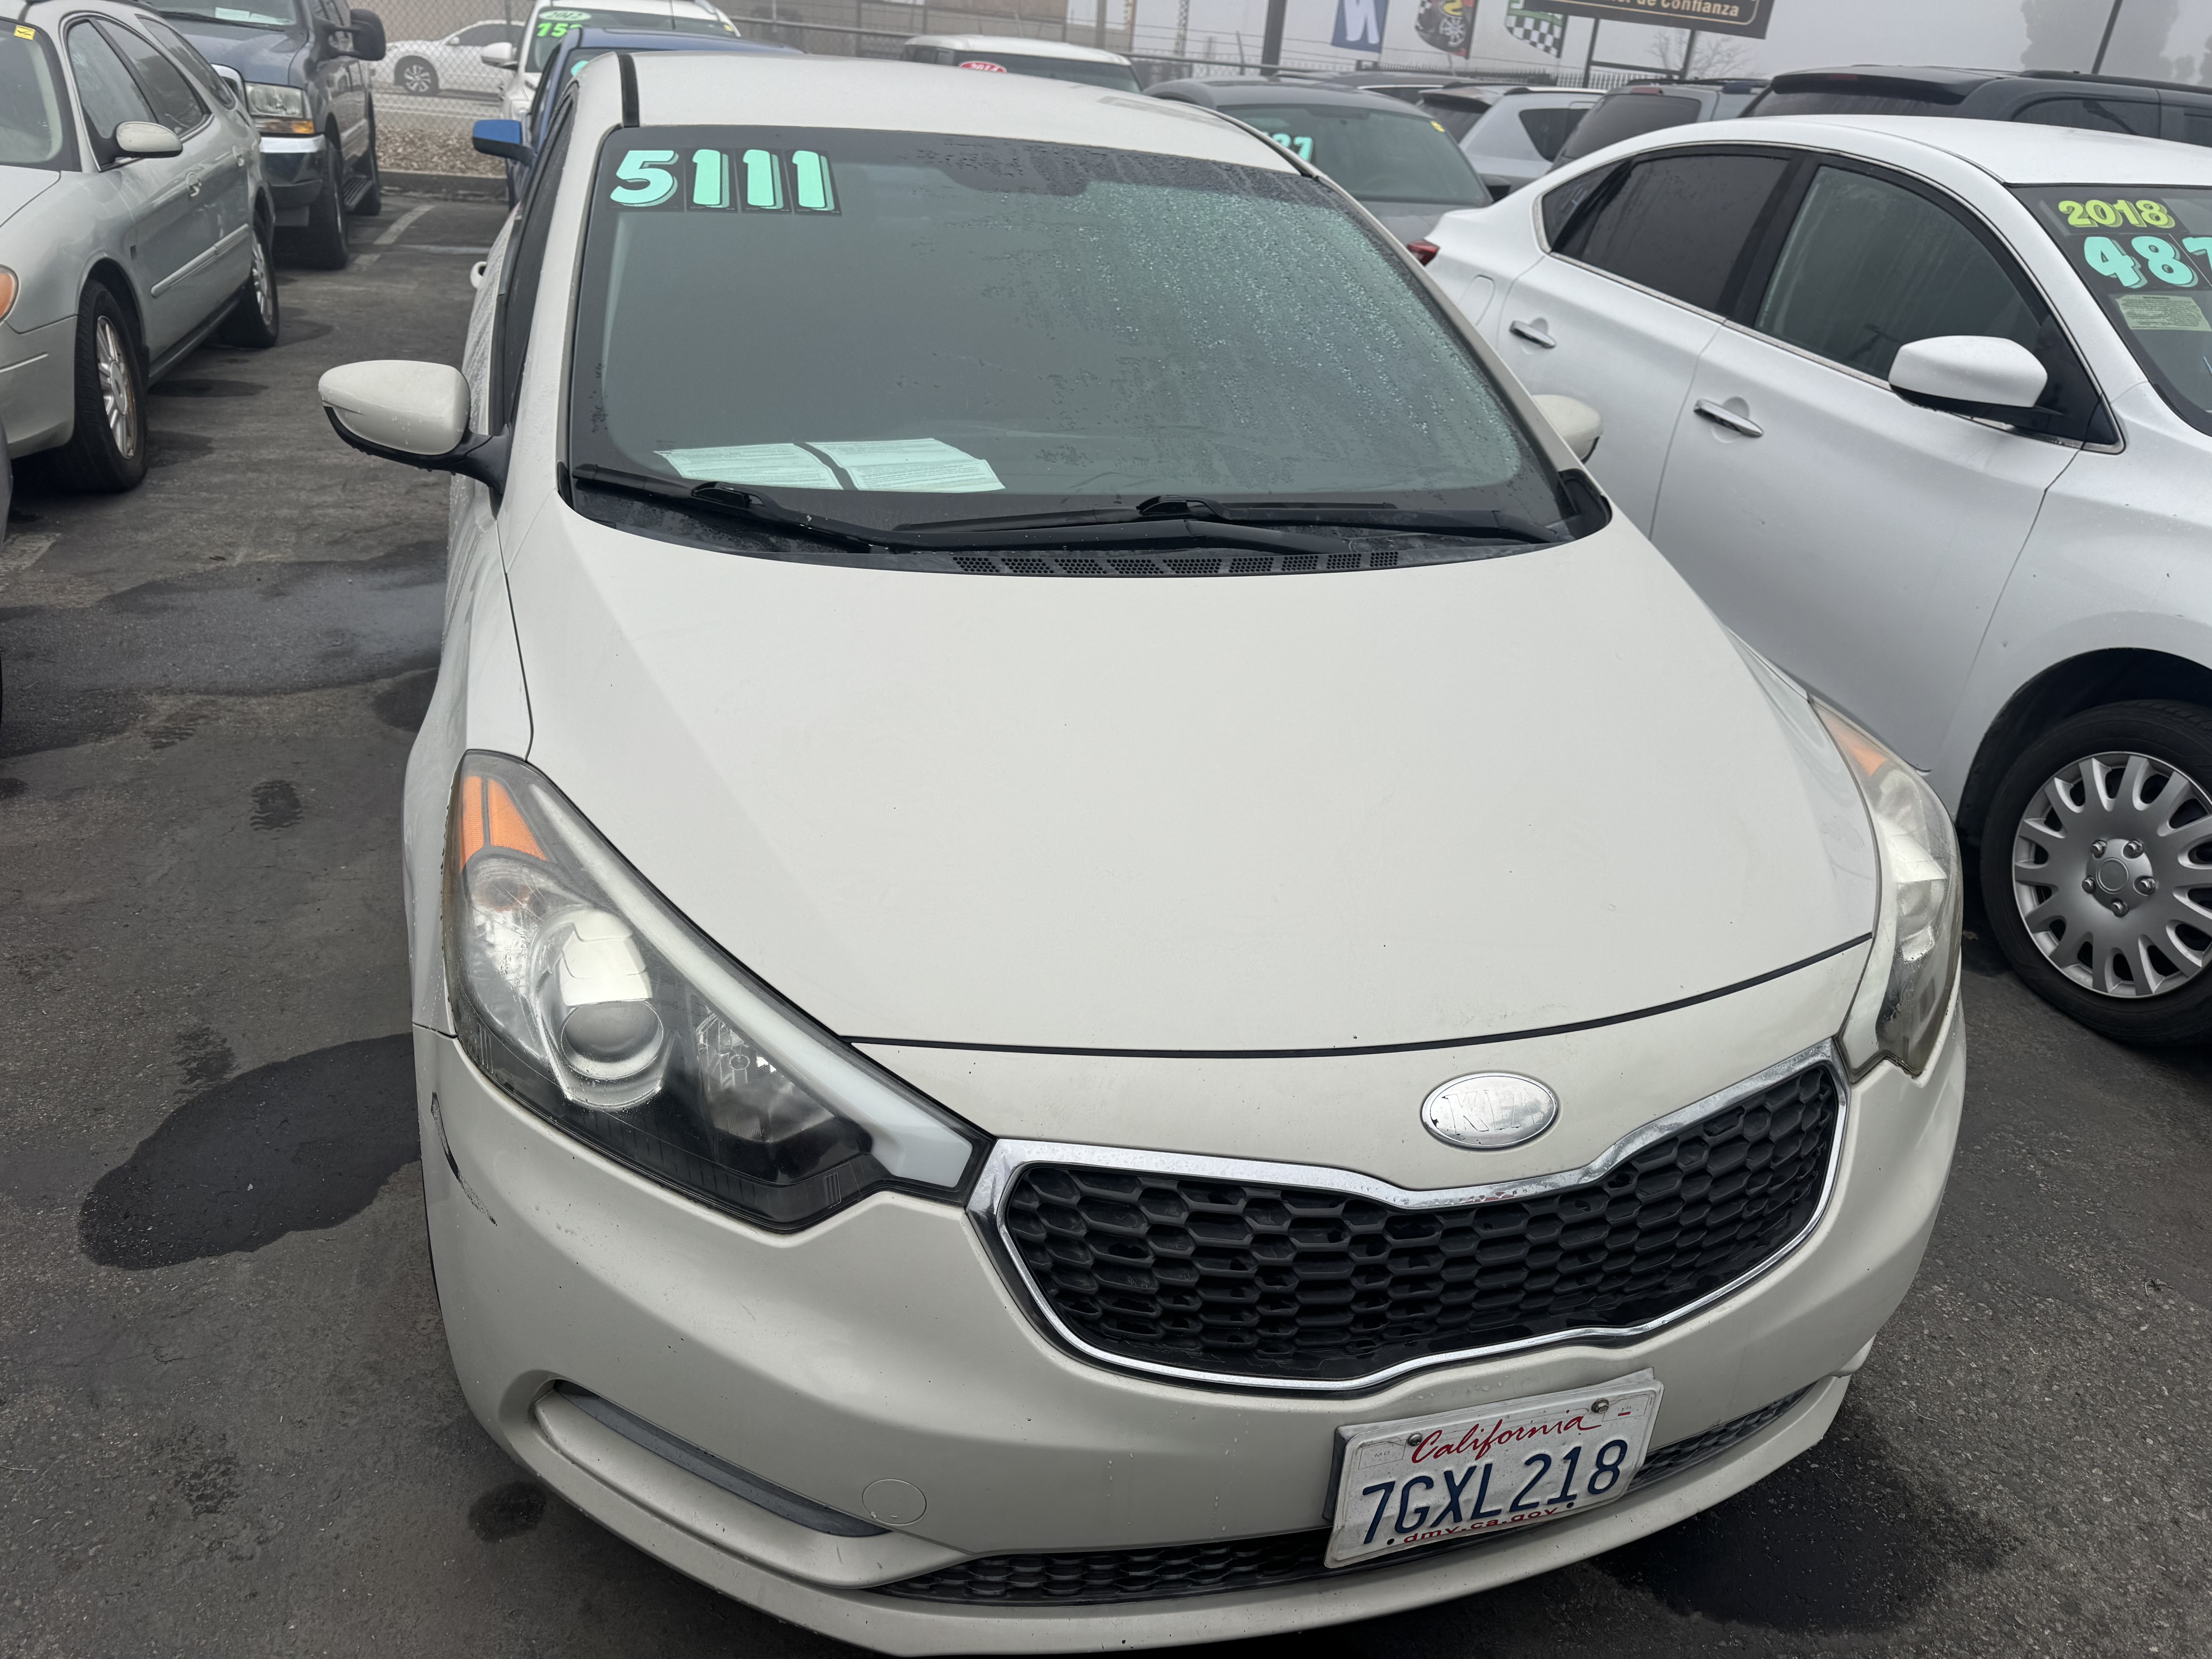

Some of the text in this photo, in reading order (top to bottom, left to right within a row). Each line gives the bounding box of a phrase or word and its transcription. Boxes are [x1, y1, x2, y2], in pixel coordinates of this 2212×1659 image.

[610, 149, 835, 211] 5111
[2058, 199, 2176, 228] 2018
[1412, 1410, 1602, 1464] California
[1362, 1439, 1628, 1545] 7GXL218
[1403, 1507, 1559, 1544] dmv.ca.gov
